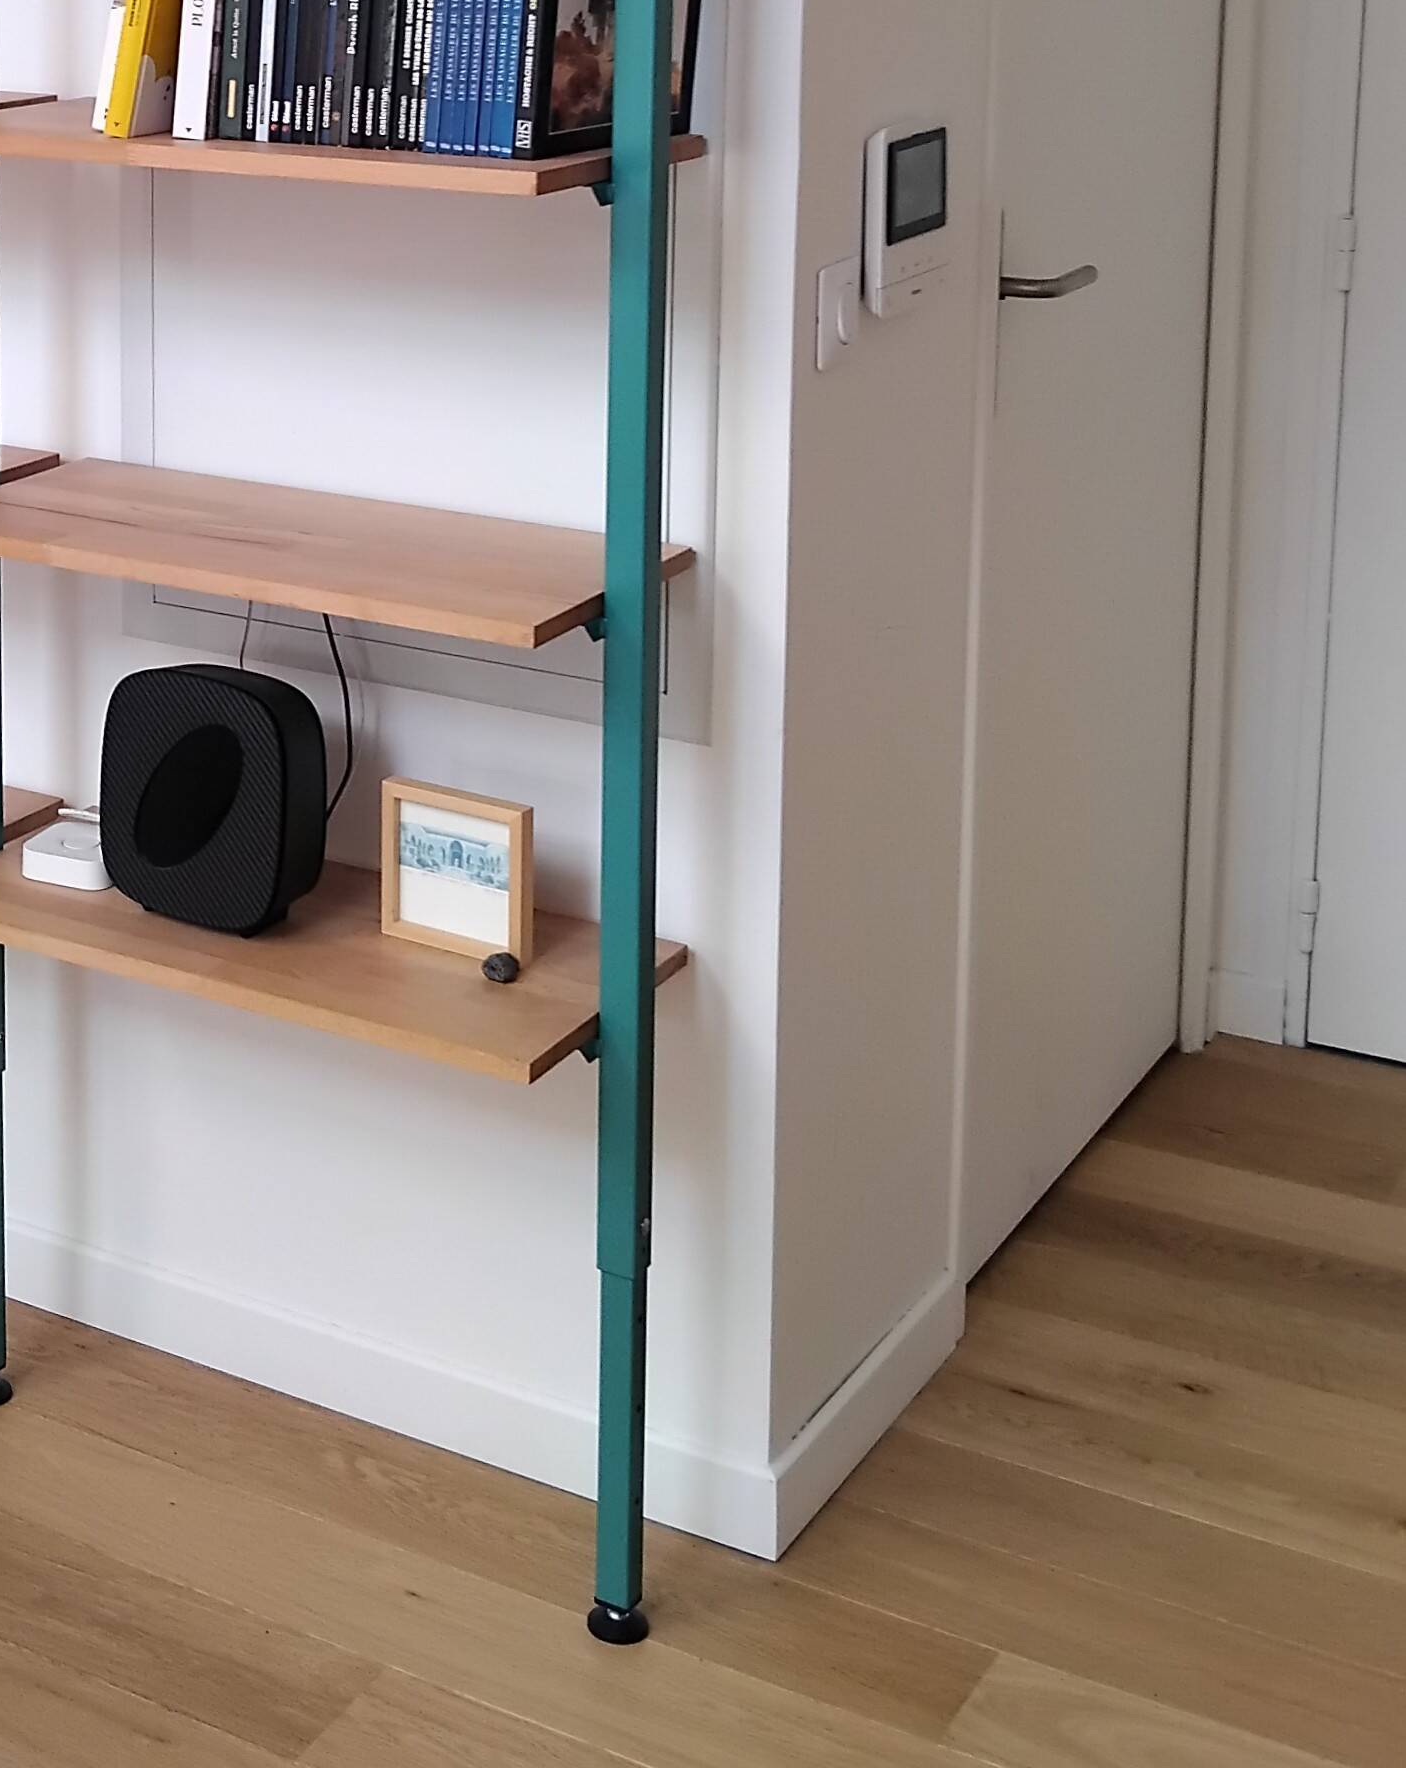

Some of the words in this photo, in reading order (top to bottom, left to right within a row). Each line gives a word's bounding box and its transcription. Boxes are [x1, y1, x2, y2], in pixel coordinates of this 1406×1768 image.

[401, 59, 410, 68] LE
[403, 25, 411, 58] DERNIER
[446, 26, 454, 79] PASSAGERS
[460, 27, 468, 80] PASSAGERS
[472, 27, 480, 80] PASSAGERS
[486, 27, 495, 81] PASSAGERS
[498, 27, 507, 80] PASSAGERS
[509, 28, 517, 82] PASSAGERS
[411, 70, 419, 85] LES
[417, 98, 427, 141] casterman
[424, 9, 433, 21] DU
[430, 80, 438, 97] LES
[444, 82, 452, 99] LES
[470, 83, 478, 100] LES
[484, 83, 492, 101] LES
[496, 83, 504, 100] LES
[507, 85, 515, 102] LES
[245, 83, 254, 129] casterman
[294, 84, 302, 130] casterman
[306, 85, 314, 131] casterman
[321, 76, 332, 127] casterman
[351, 85, 361, 133] casterman
[364, 87, 374, 136] casterman
[377, 87, 389, 136] casterman
[397, 94, 407, 138] casterman
[407, 97, 418, 141] casterman
